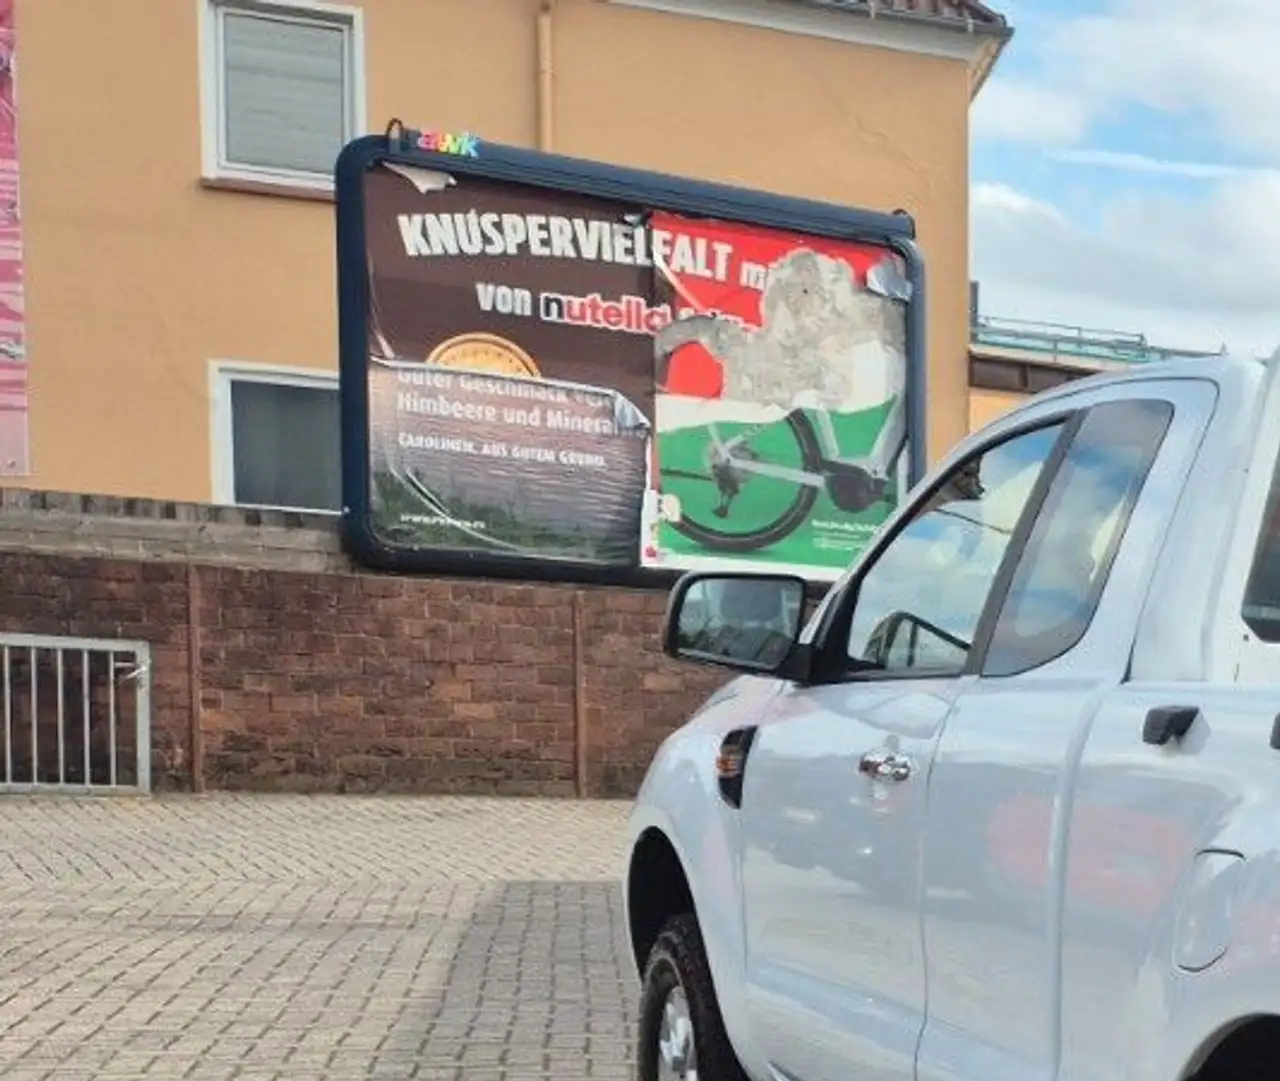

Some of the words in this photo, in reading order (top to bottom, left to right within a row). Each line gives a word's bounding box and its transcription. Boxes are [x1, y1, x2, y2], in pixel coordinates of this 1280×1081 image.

[397, 210, 733, 282] KNUSPERVIELFALT
[475, 282, 533, 316] von
[540, 292, 672, 333] nutella
[396, 391, 499, 422] Himbeere
[503, 405, 542, 427] und
